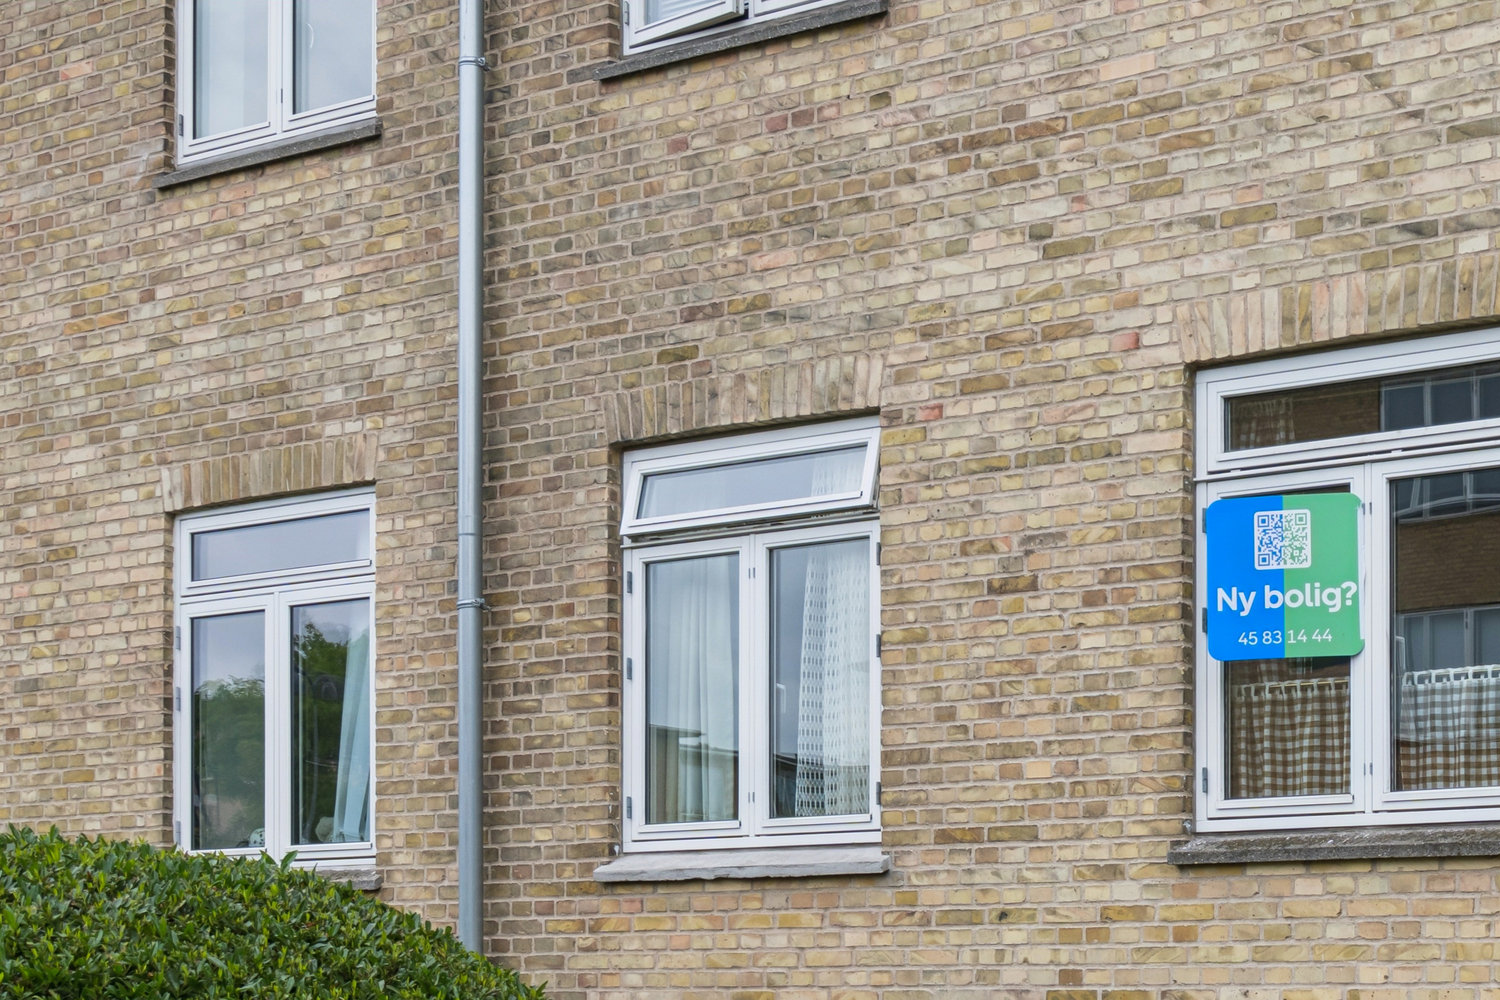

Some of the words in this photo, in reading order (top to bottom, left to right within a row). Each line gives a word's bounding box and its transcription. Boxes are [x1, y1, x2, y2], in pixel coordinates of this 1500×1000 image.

[1217, 586, 1257, 617] Ny
[1264, 581, 1358, 613] bolig?
[1238, 631, 1258, 645] 45
[1262, 630, 1282, 644] 83
[1287, 629, 1308, 643] 14
[1311, 628, 1333, 642] 44
